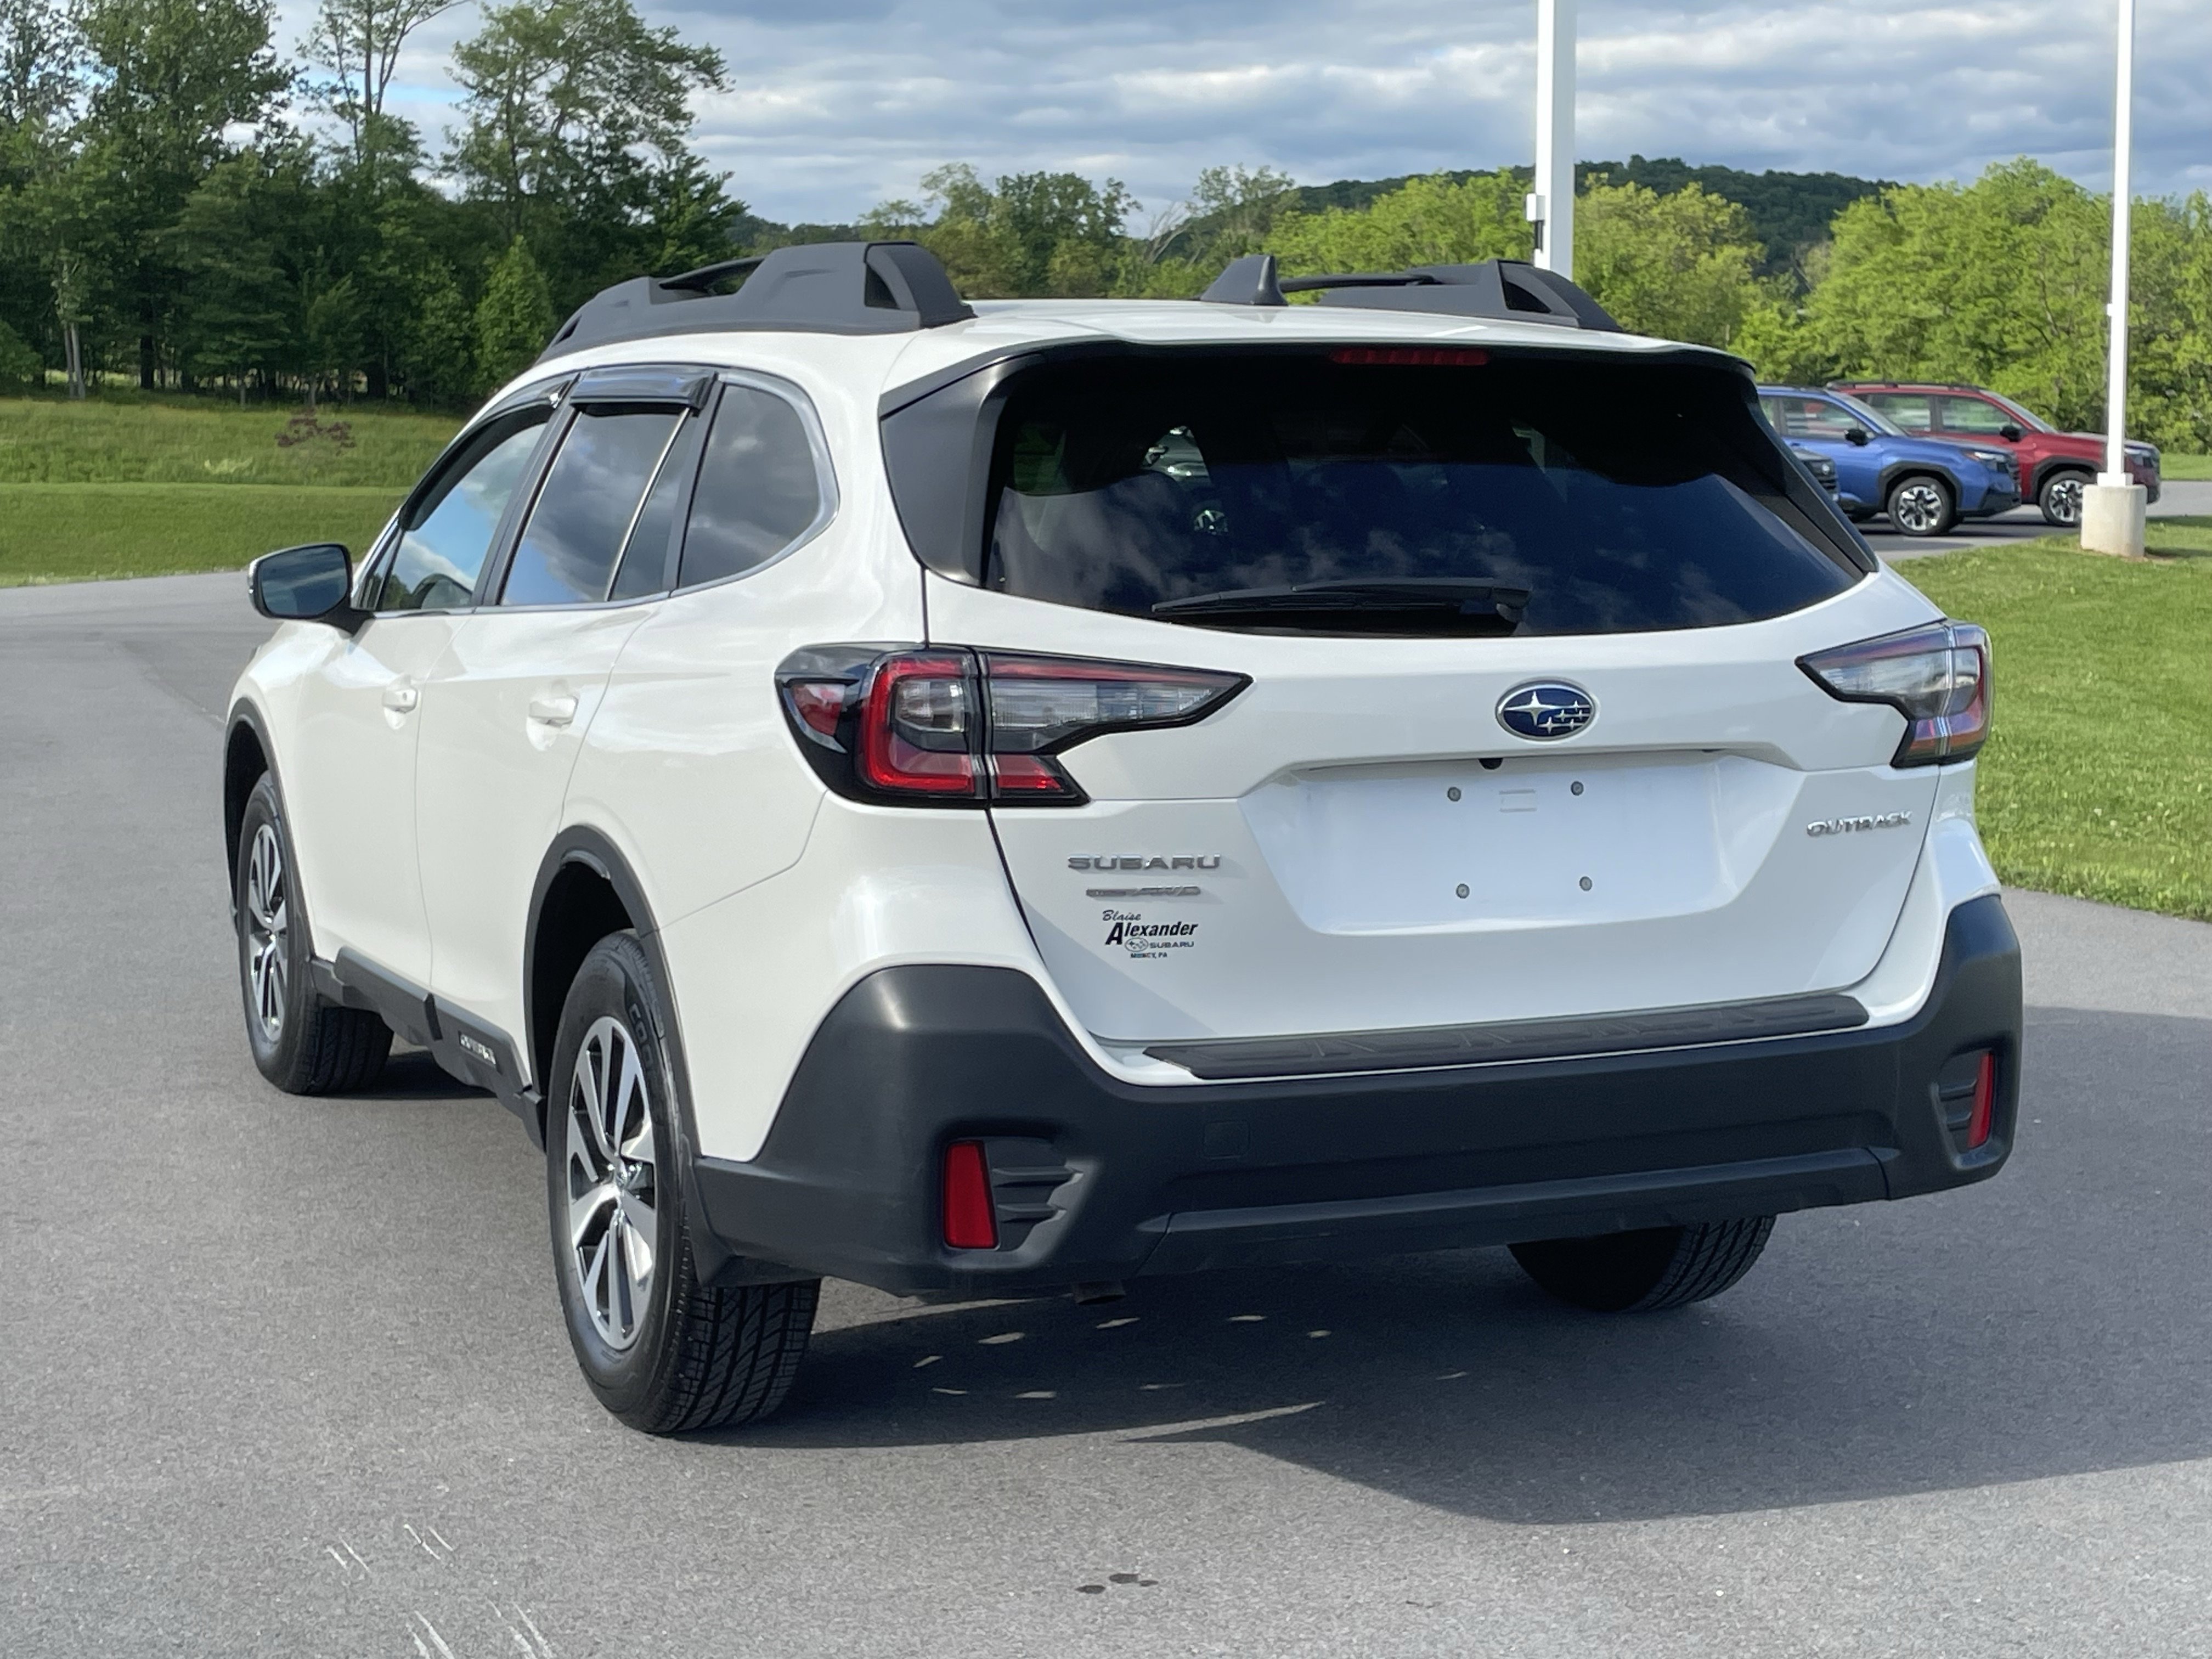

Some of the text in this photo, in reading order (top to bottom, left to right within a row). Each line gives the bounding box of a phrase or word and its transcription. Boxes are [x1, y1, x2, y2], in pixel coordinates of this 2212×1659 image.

[1068, 854, 1220, 870] SUBARU
[1102, 910, 1141, 921] Blaise
[1105, 922, 1199, 945] Alexander
